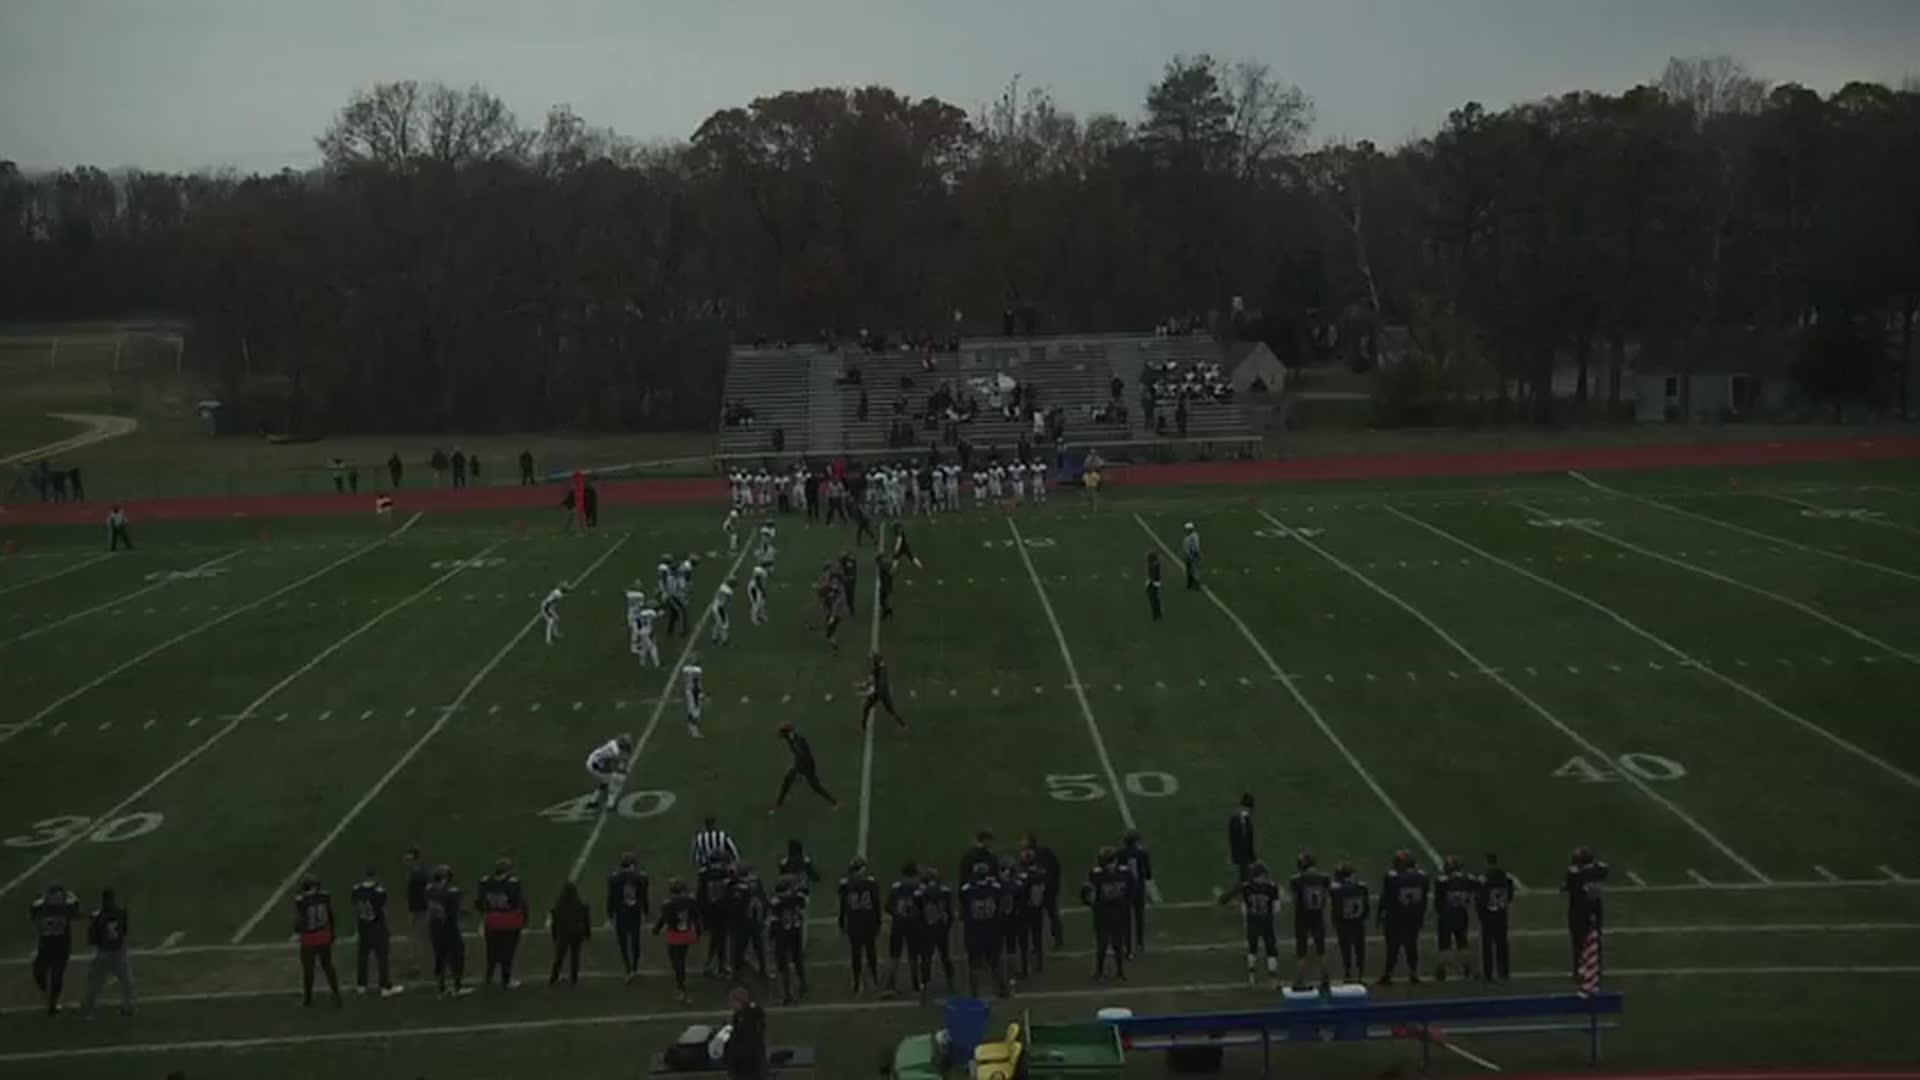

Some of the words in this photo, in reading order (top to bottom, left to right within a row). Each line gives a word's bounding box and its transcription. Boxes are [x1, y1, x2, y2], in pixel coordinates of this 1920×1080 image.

[1550, 752, 1687, 783] 40
[1045, 771, 1178, 801] 50
[537, 790, 676, 823] 40
[3, 812, 164, 847] 30
